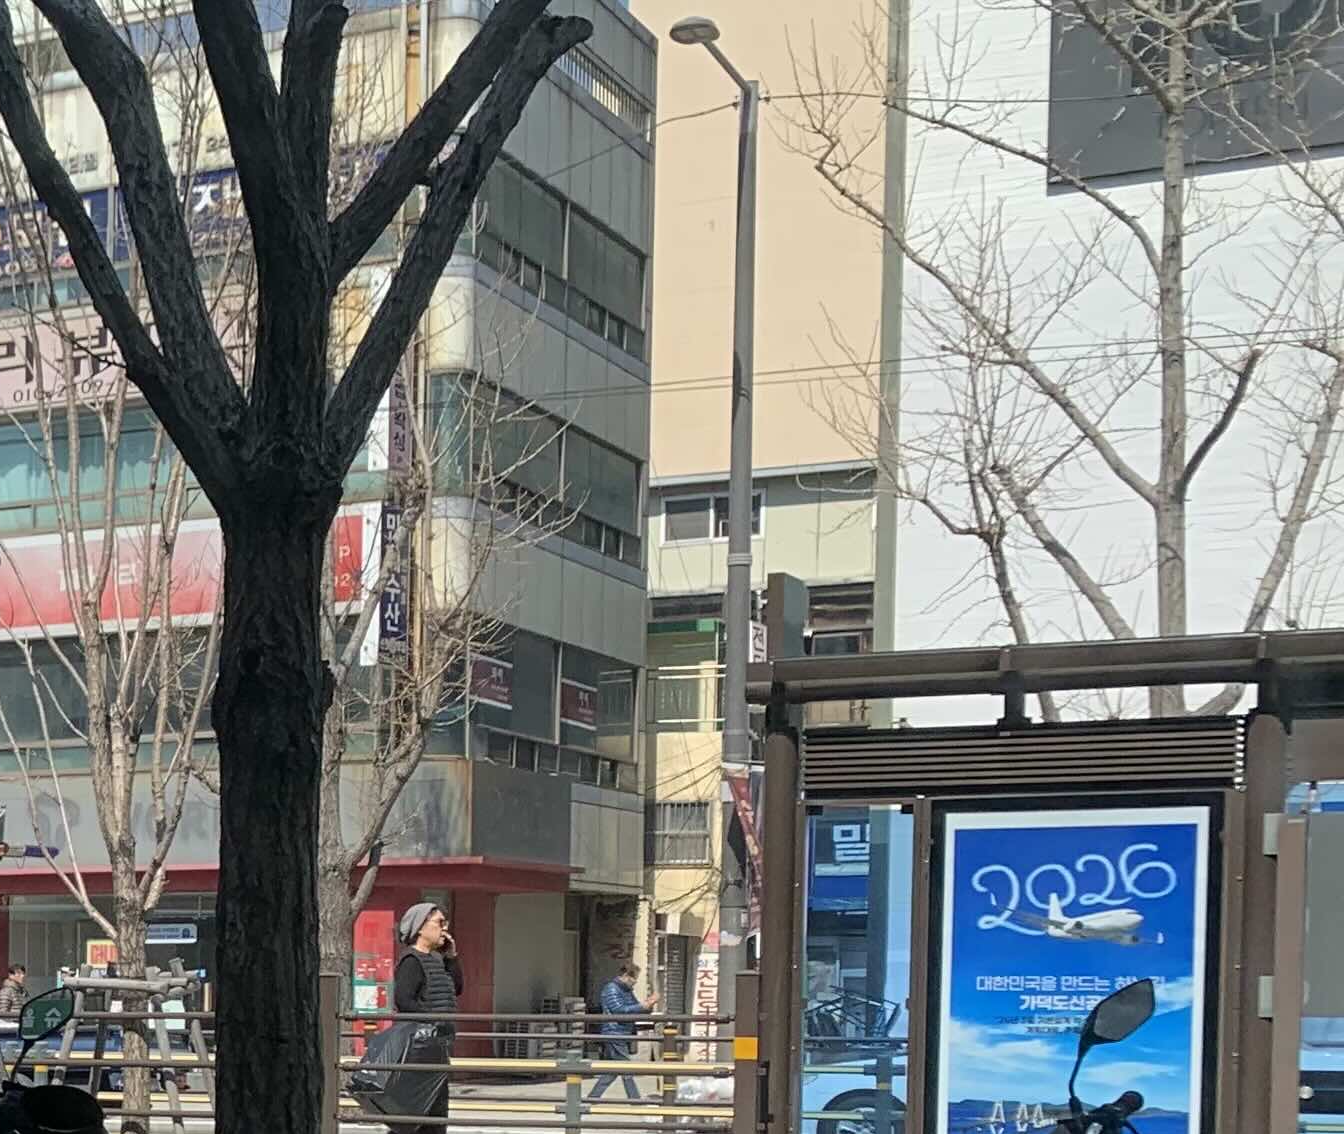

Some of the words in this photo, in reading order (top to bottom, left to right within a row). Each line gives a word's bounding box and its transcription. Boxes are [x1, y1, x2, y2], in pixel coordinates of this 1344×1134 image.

[971, 843, 1177, 936] 2026
[976, 975, 1058, 992] 대한민국을
[1061, 975, 1111, 992] 만드는
[1019, 994, 1106, 1012] 가덕도신공
